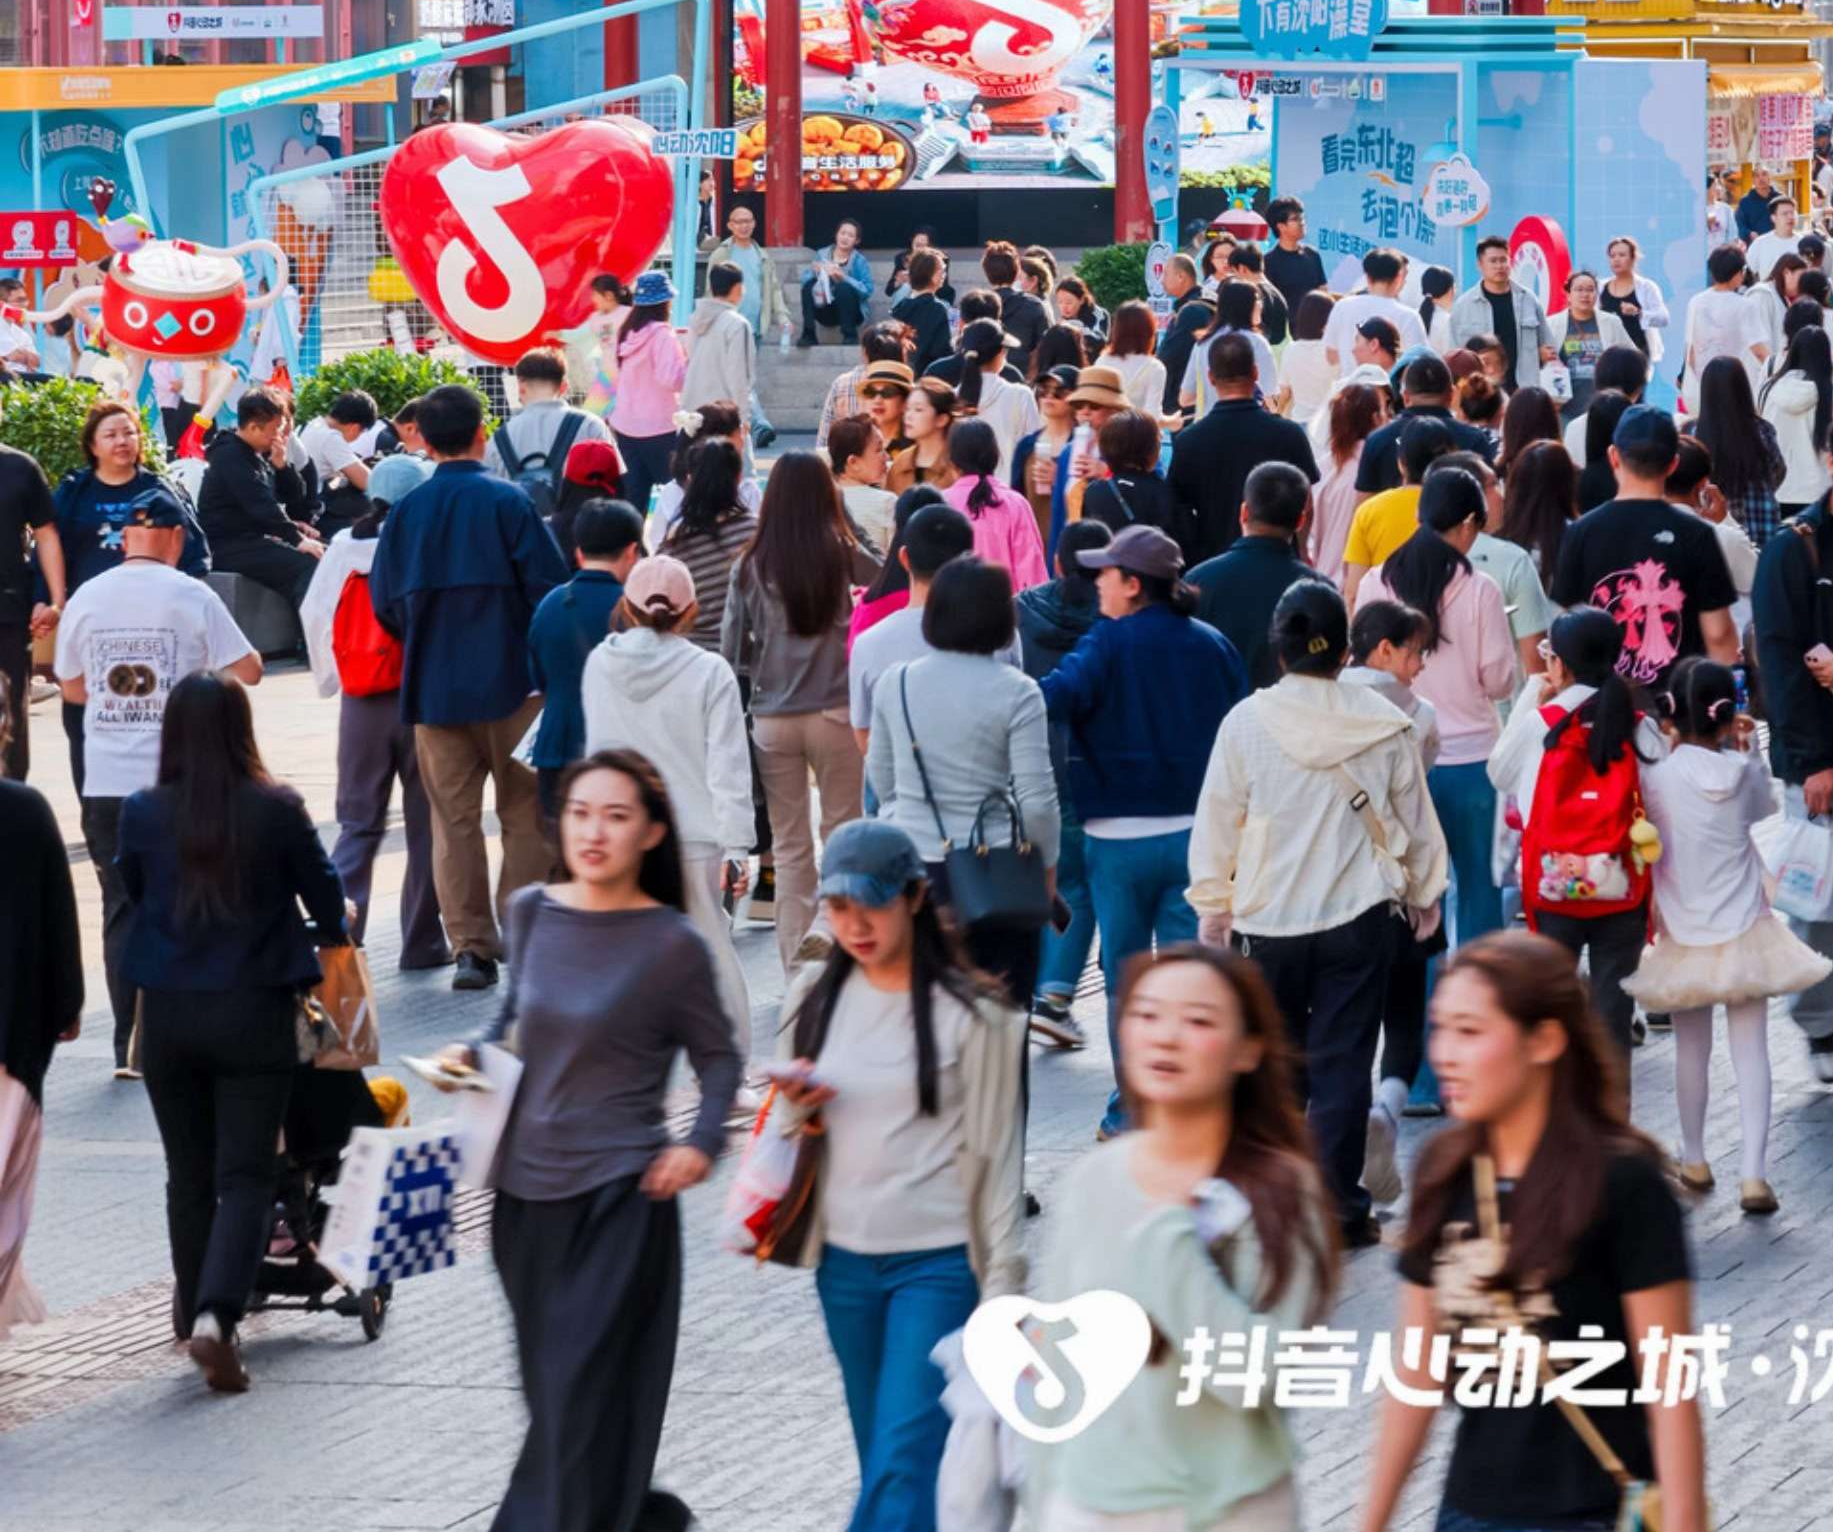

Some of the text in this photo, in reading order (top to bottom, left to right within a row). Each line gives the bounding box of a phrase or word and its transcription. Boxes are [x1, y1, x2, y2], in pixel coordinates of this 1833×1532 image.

[1321, 123, 1416, 185] 看完东北超
